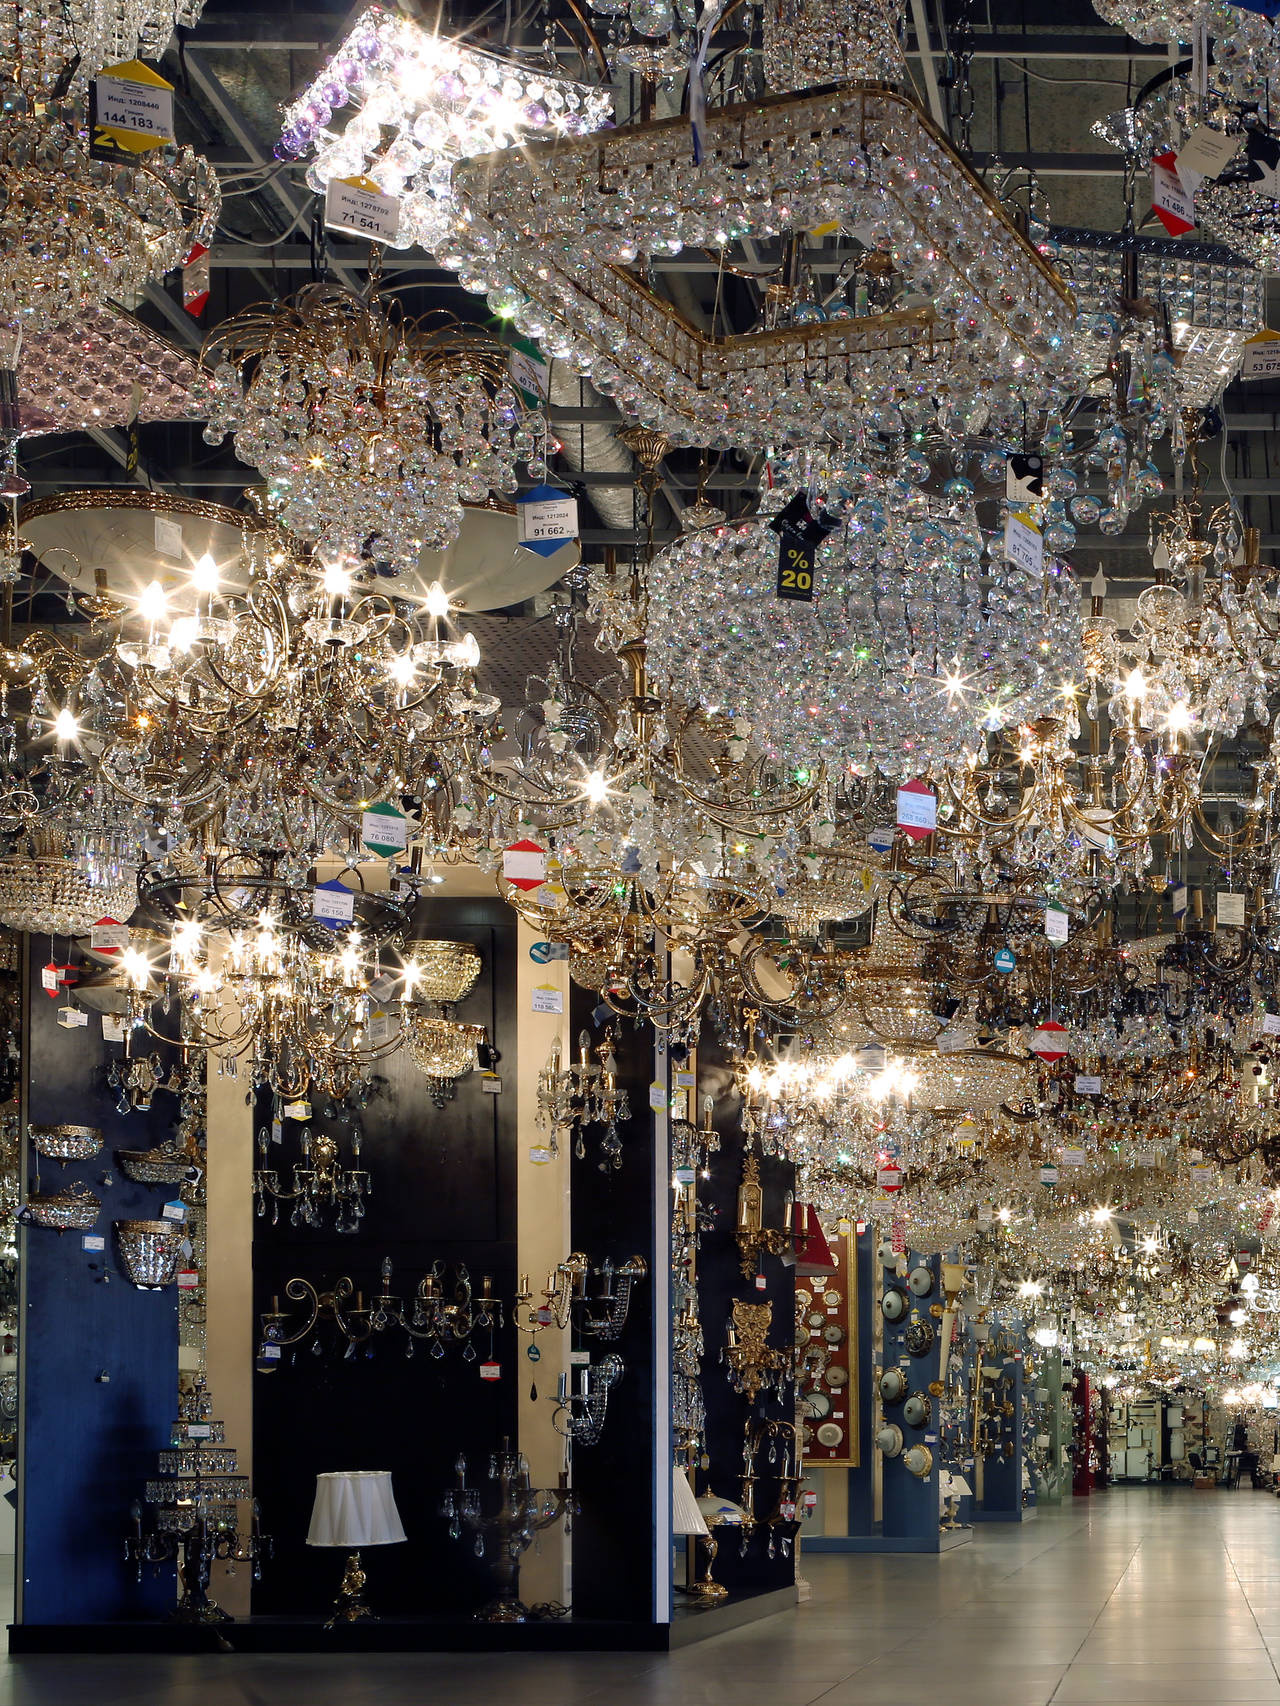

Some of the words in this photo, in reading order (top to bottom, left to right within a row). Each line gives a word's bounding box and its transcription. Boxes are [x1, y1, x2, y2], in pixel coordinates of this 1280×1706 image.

[103, 112, 127, 125] 144
[130, 116, 154, 129] 183
[1161, 196, 1170, 208] 71
[1172, 203, 1186, 216] 486
[342, 212, 355, 224] 71
[360, 218, 380, 231] 541
[1253, 363, 1264, 372] 53
[534, 528, 545, 536] 91
[547, 527, 565, 535] 662
[788, 549, 809, 569] %
[781, 569, 812, 590] 20
